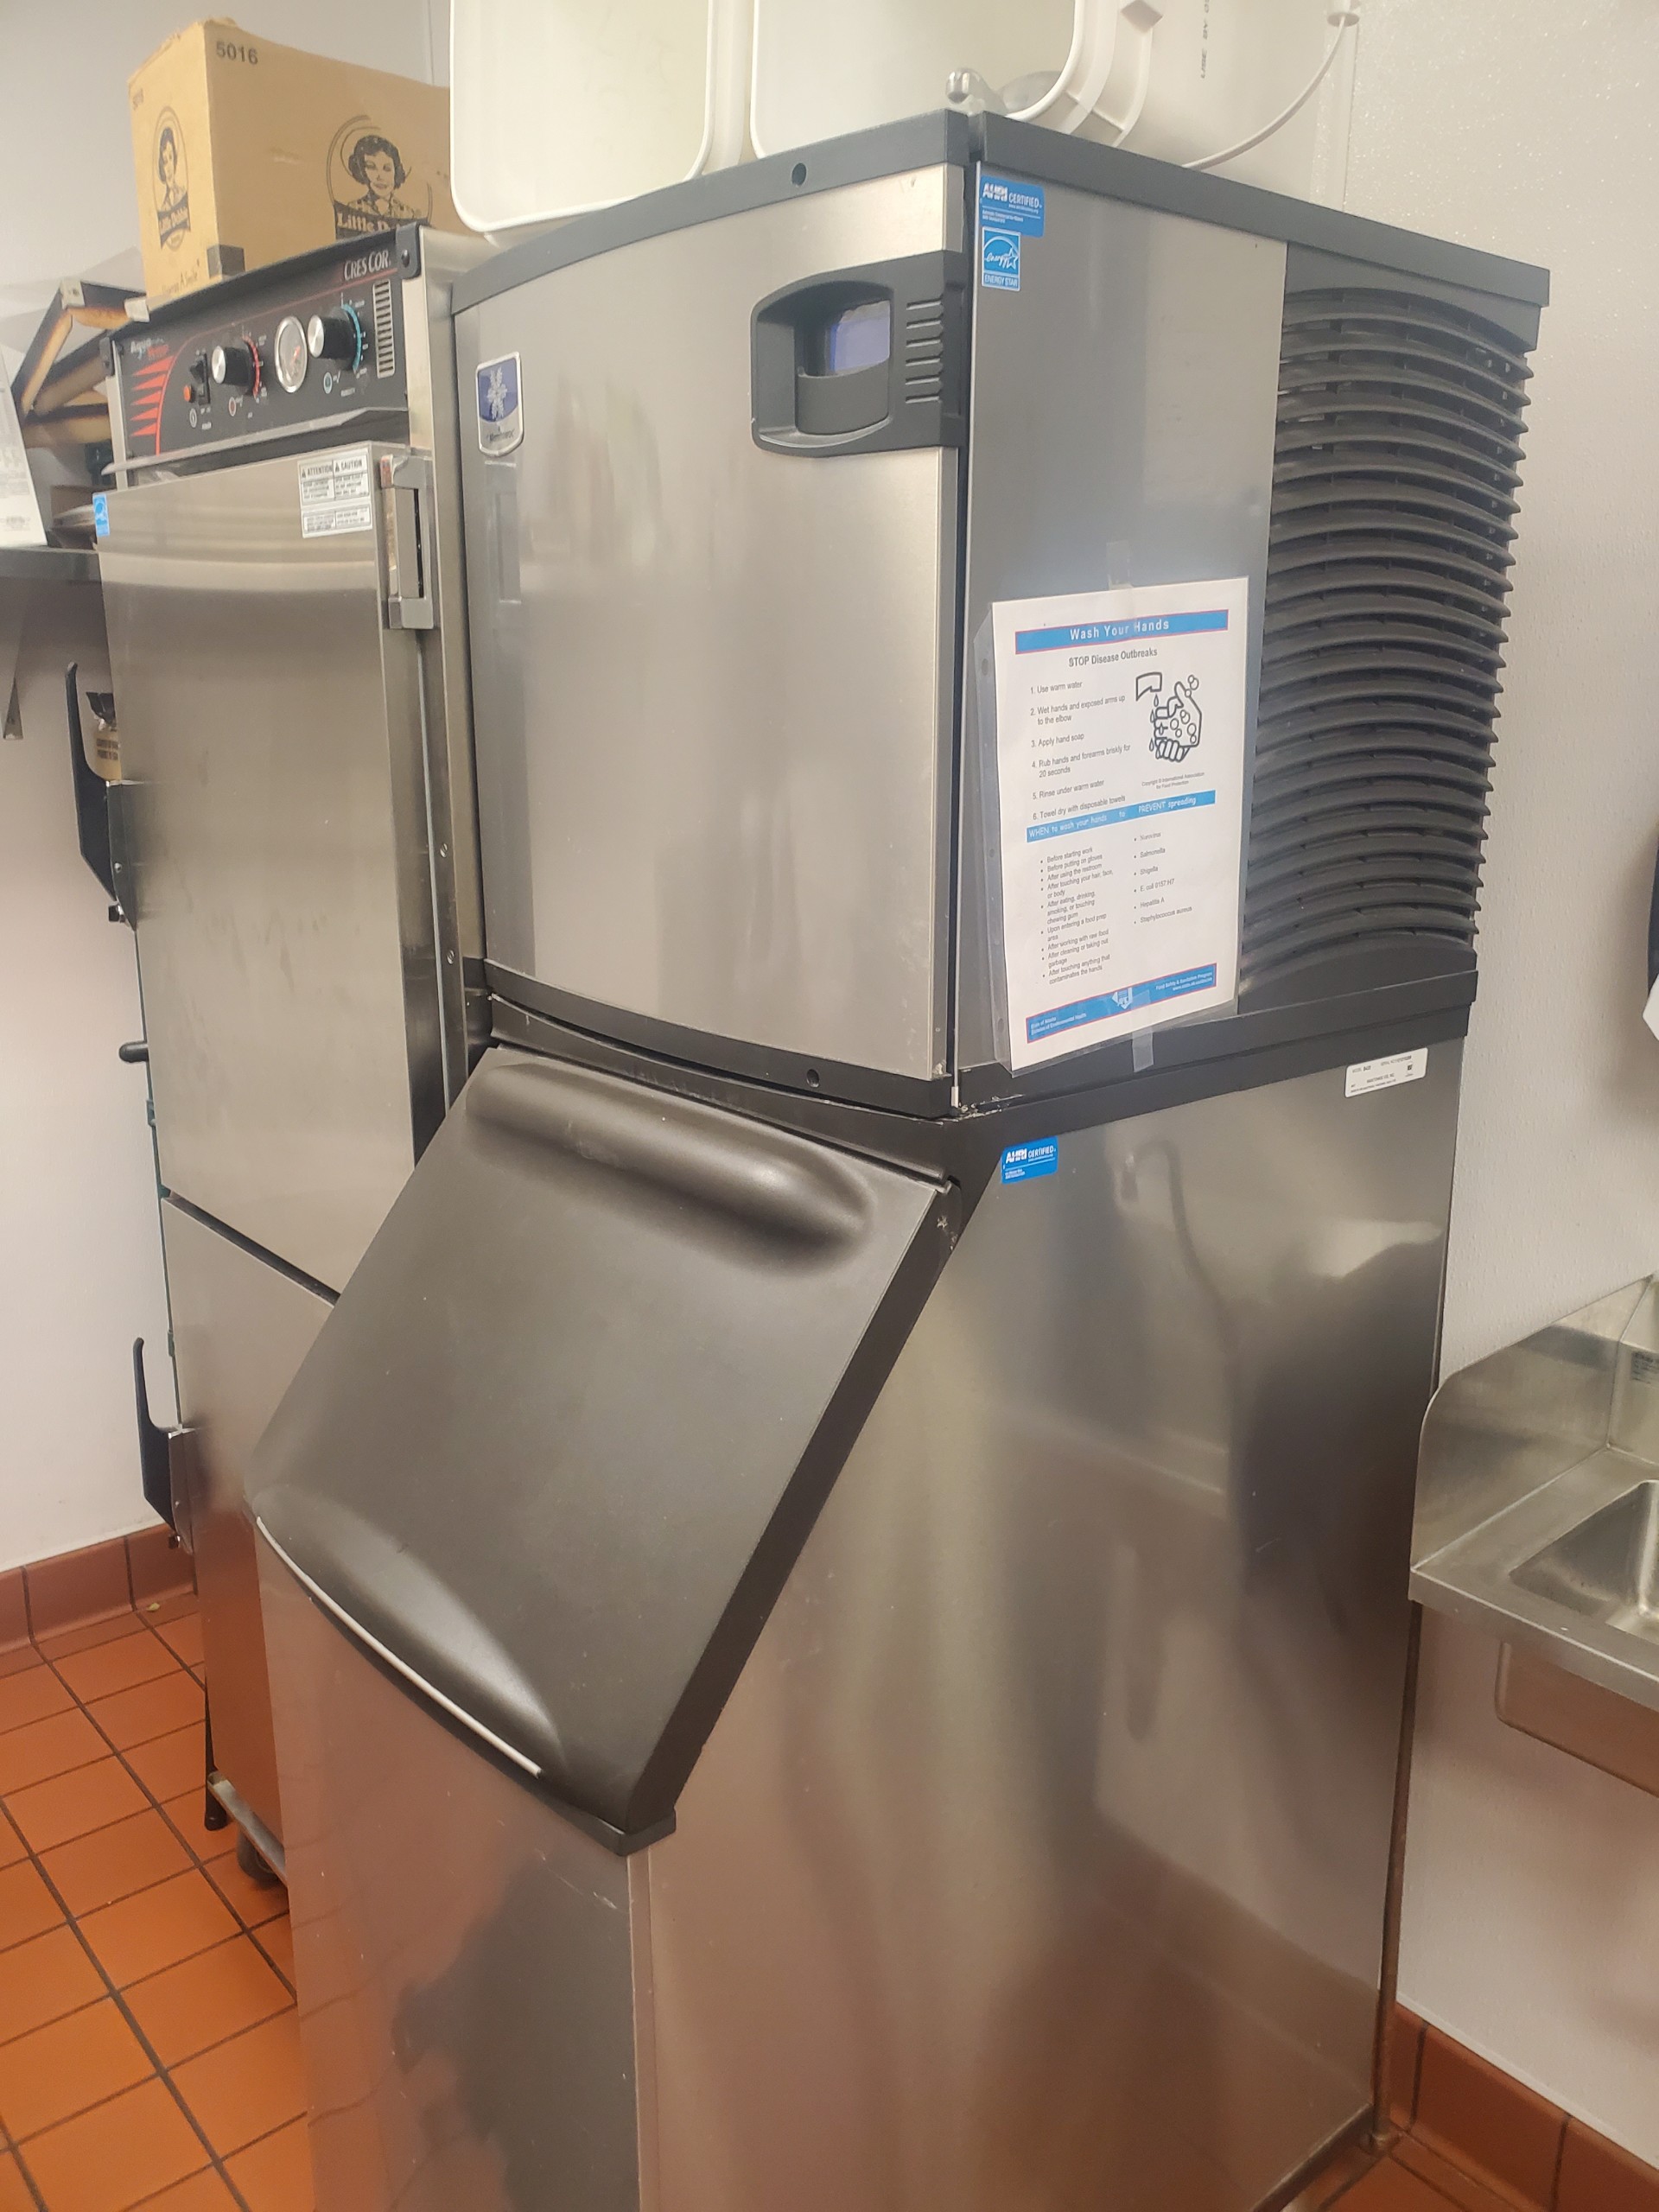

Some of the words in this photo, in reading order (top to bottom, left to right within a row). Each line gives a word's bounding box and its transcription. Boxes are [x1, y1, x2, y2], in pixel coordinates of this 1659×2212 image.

[215, 41, 258, 65] 5016
[1008, 192, 1039, 208] CERTIFIED
[336, 213, 375, 233] Little
[984, 274, 1005, 286] ENERGY
[1004, 276, 1018, 287] STAR
[307, 464, 333, 476] ATTENTION
[340, 459, 362, 470] CAUTION
[1070, 626, 1099, 640] Wash
[1104, 625, 1129, 637] Your
[1134, 619, 1169, 632] Hands
[1069, 657, 1090, 668] STOP
[1091, 653, 1119, 664] Disease
[1120, 648, 1158, 660] Outbreaks
[1037, 685, 1048, 694] Use
[1051, 683, 1066, 692] warm
[1067, 681, 1083, 690] water
[1051, 703, 1068, 713] hands
[1069, 702, 1080, 710] and
[1081, 698, 1104, 709] exposed
[1104, 696, 1117, 704] arms
[1037, 717, 1043, 726] to
[1045, 716, 1054, 725] the
[1055, 714, 1072, 723] elbow
[1038, 737, 1055, 747] Apply
[1056, 734, 1071, 744] hand
[1071, 733, 1084, 742] soap
[1039, 759, 1052, 768] Rub
[1052, 755, 1069, 766] hands
[1070, 753, 1081, 762] and
[1082, 749, 1105, 760] forearms
[1106, 745, 1122, 755] briskly
[1039, 769, 1046, 779] 20
[1047, 766, 1071, 777] seconds
[1039, 790, 1056, 799] Rinse
[1056, 785, 1072, 796] under
[1073, 782, 1090, 792] warm
[1090, 779, 1104, 789] water
[1039, 809, 1057, 819] Towel
[1058, 807, 1067, 817] dry
[1068, 804, 1079, 813] with
[1079, 798, 1109, 811] disposable
[1109, 794, 1126, 804] towels
[1028, 827, 1050, 838] WHEN
[1060, 821, 1075, 831] wash
[1076, 818, 1089, 829] your
[1090, 814, 1107, 823] hands
[1138, 801, 1166, 814] PREVENT
[1167, 796, 1197, 810] spreading
[1046, 855, 1064, 863] Before
[1064, 849, 1081, 859] starting
[1082, 846, 1093, 855] work
[1046, 873, 1059, 881] After
[1059, 870, 1073, 879] using
[1082, 863, 1103, 873] restroom
[1047, 863, 1064, 873] Before
[1064, 859, 1080, 869] putting
[1087, 854, 1103, 864] gloves
[1027, 1145, 1054, 1159] CERTIFIED
